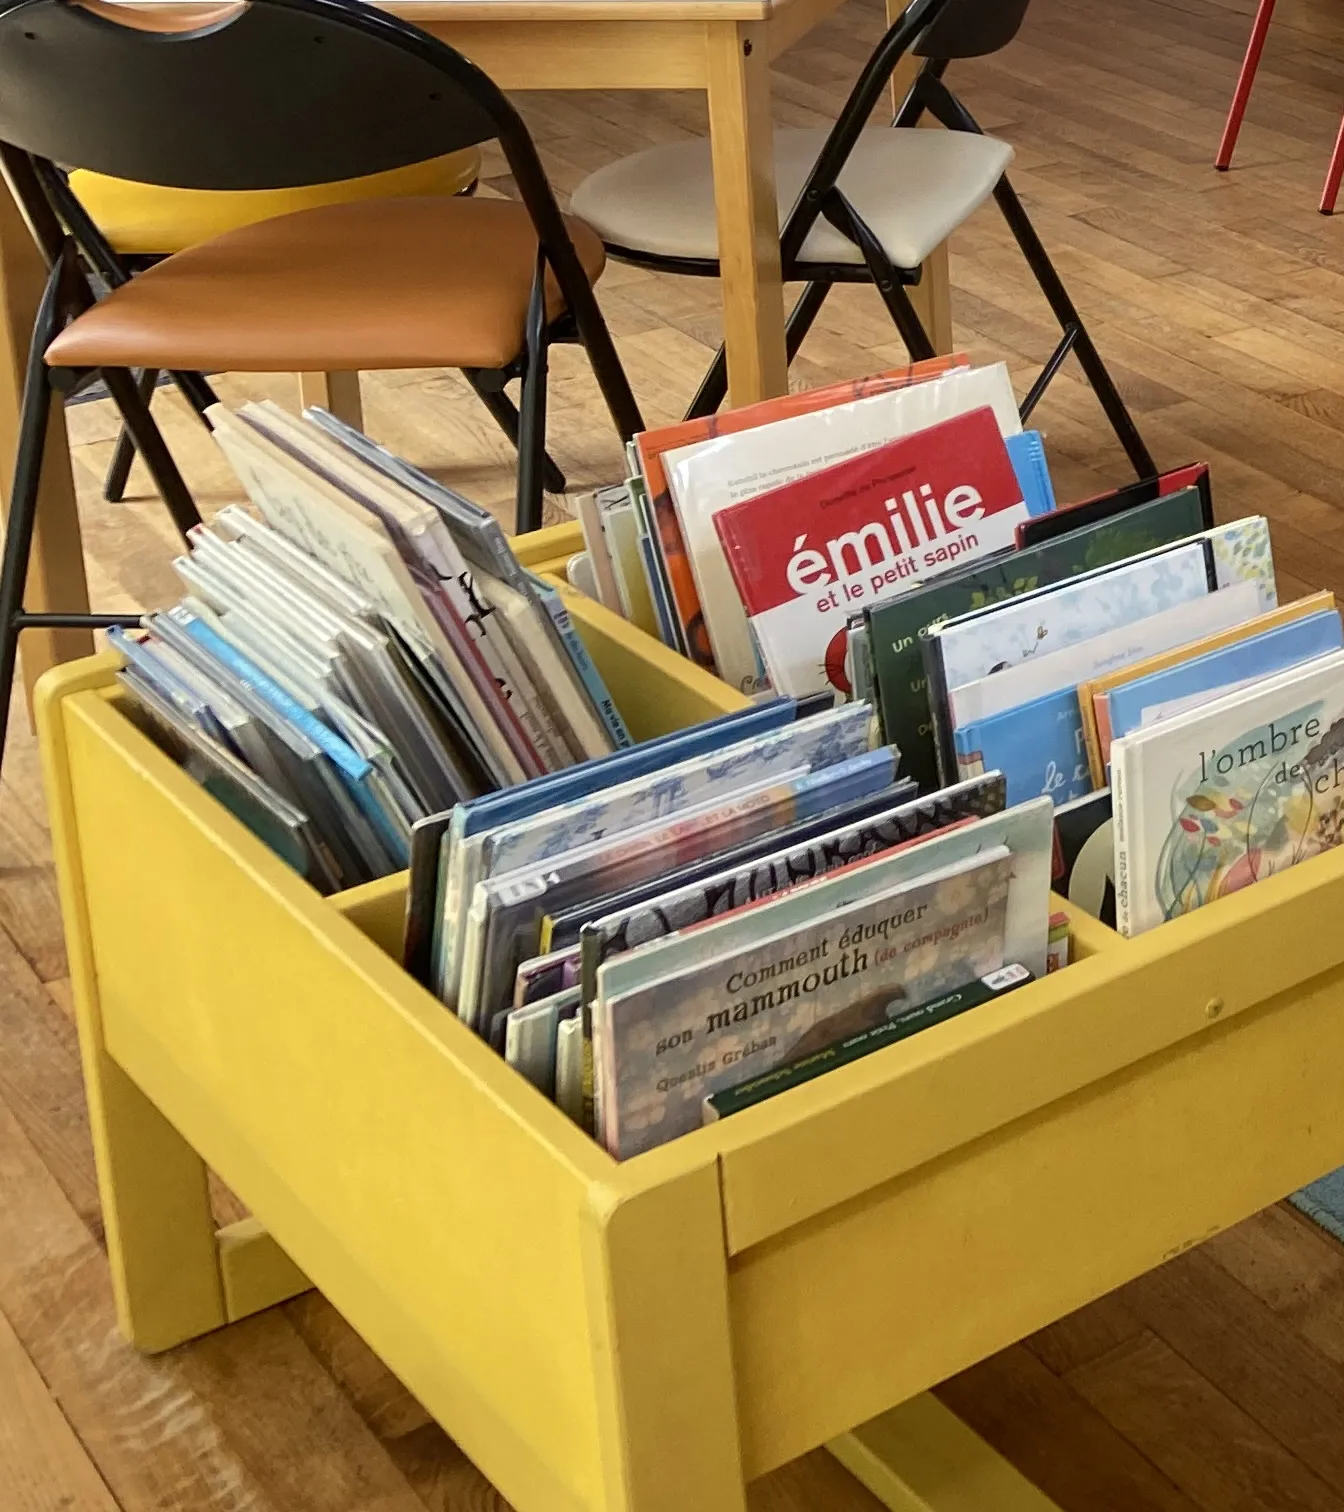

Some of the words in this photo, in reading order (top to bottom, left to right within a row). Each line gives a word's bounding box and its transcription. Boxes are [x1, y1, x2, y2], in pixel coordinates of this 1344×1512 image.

[786, 483, 986, 595] émilie
[816, 591, 840, 613] et
[843, 583, 865, 602] le
[870, 555, 919, 594] petit
[923, 533, 979, 567] sapin
[891, 635, 914, 654] Un
[1199, 716, 1322, 784] l'ombre
[1275, 762, 1301, 786] de
[1117, 850, 1129, 910] chacun
[726, 938, 830, 994] Comment
[838, 903, 929, 951] éduquer
[655, 1027, 694, 1056] son
[706, 948, 869, 1034] mammouth
